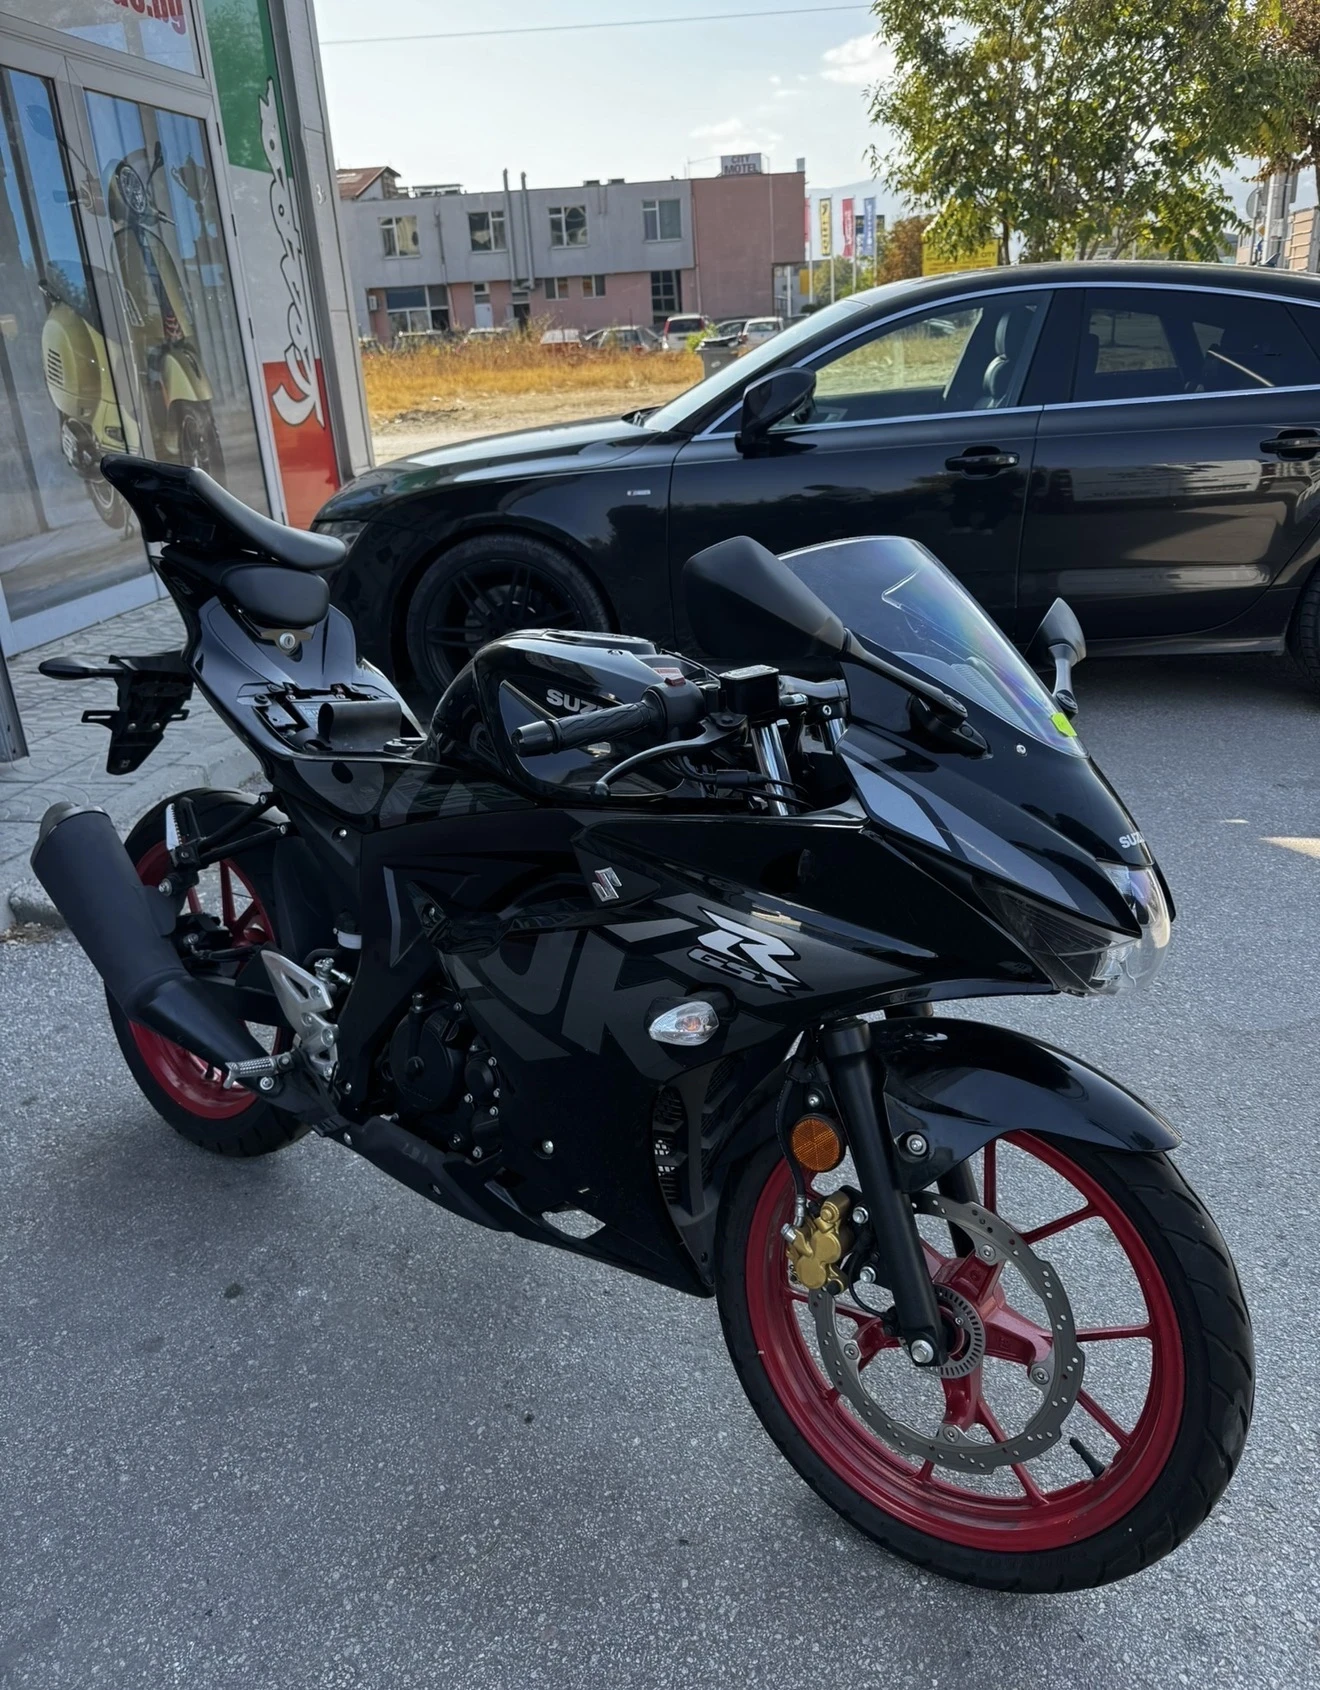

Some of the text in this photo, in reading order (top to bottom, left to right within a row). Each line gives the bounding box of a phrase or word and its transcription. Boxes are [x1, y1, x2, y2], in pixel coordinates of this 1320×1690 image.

[731, 154, 751, 163] CITY
[724, 163, 758, 174] MOTEL
[546, 689, 603, 715] SUZ
[1119, 831, 1145, 849] SUZ
[688, 948, 800, 994] GSX
